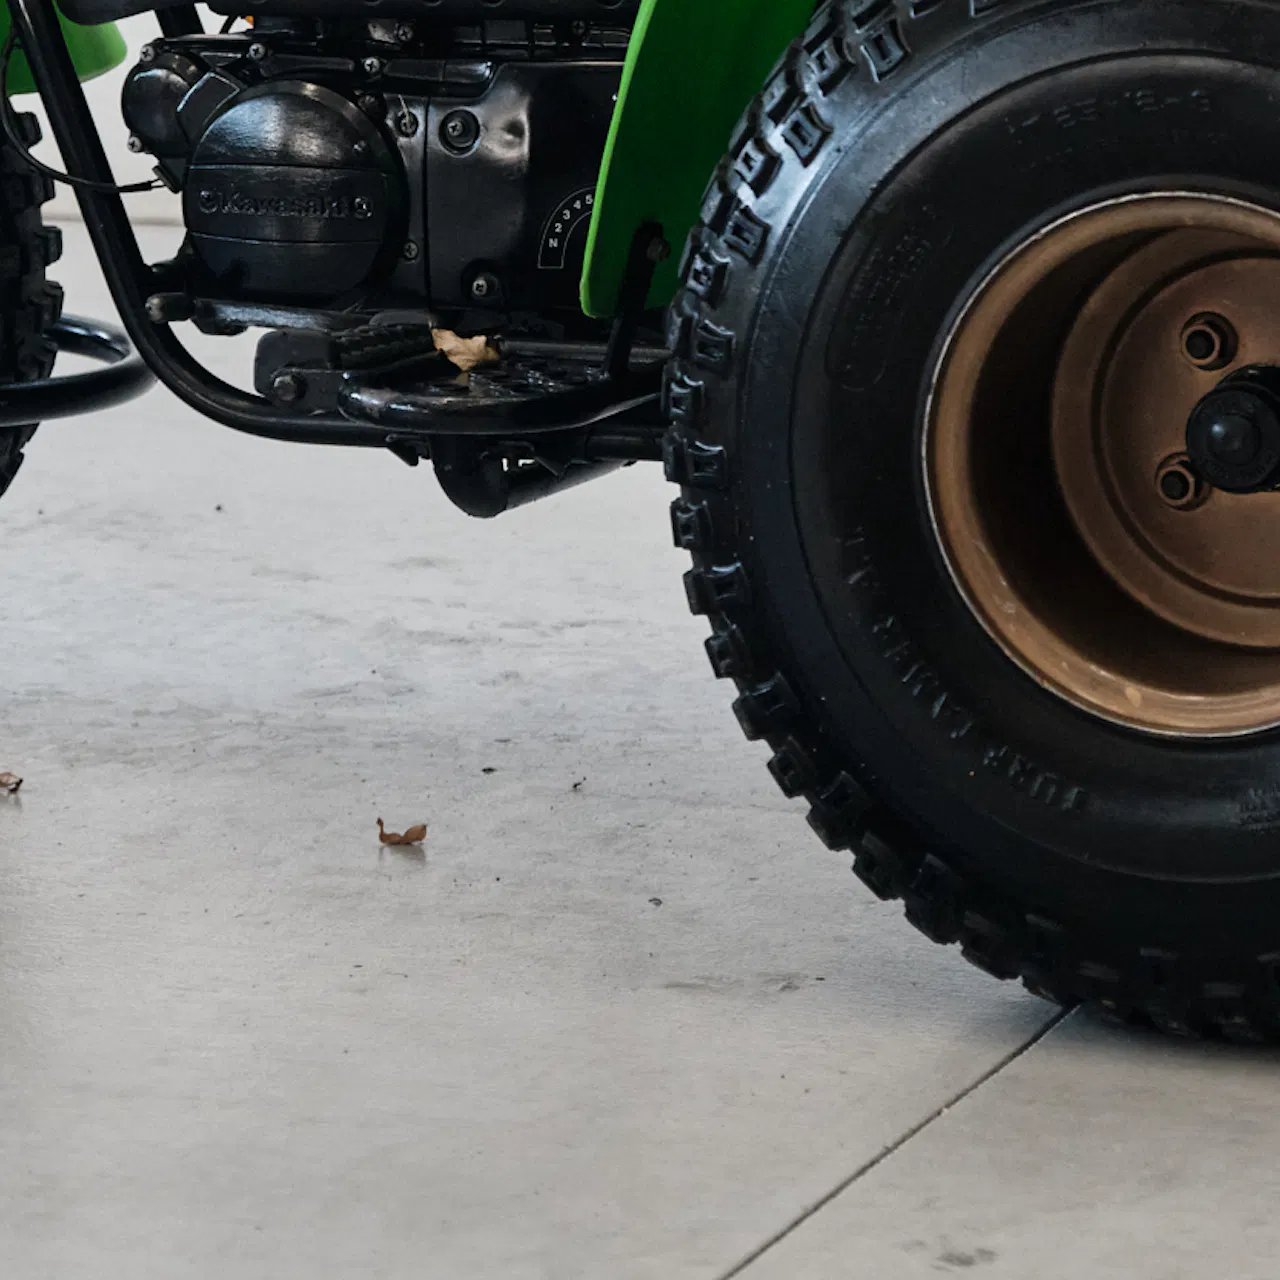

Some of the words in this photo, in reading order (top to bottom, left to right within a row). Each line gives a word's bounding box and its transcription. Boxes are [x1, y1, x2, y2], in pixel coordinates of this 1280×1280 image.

[548, 237, 558, 248] N
[554, 222, 563, 233] 2
[562, 208, 571, 220] 3
[573, 199, 582, 210] 4
